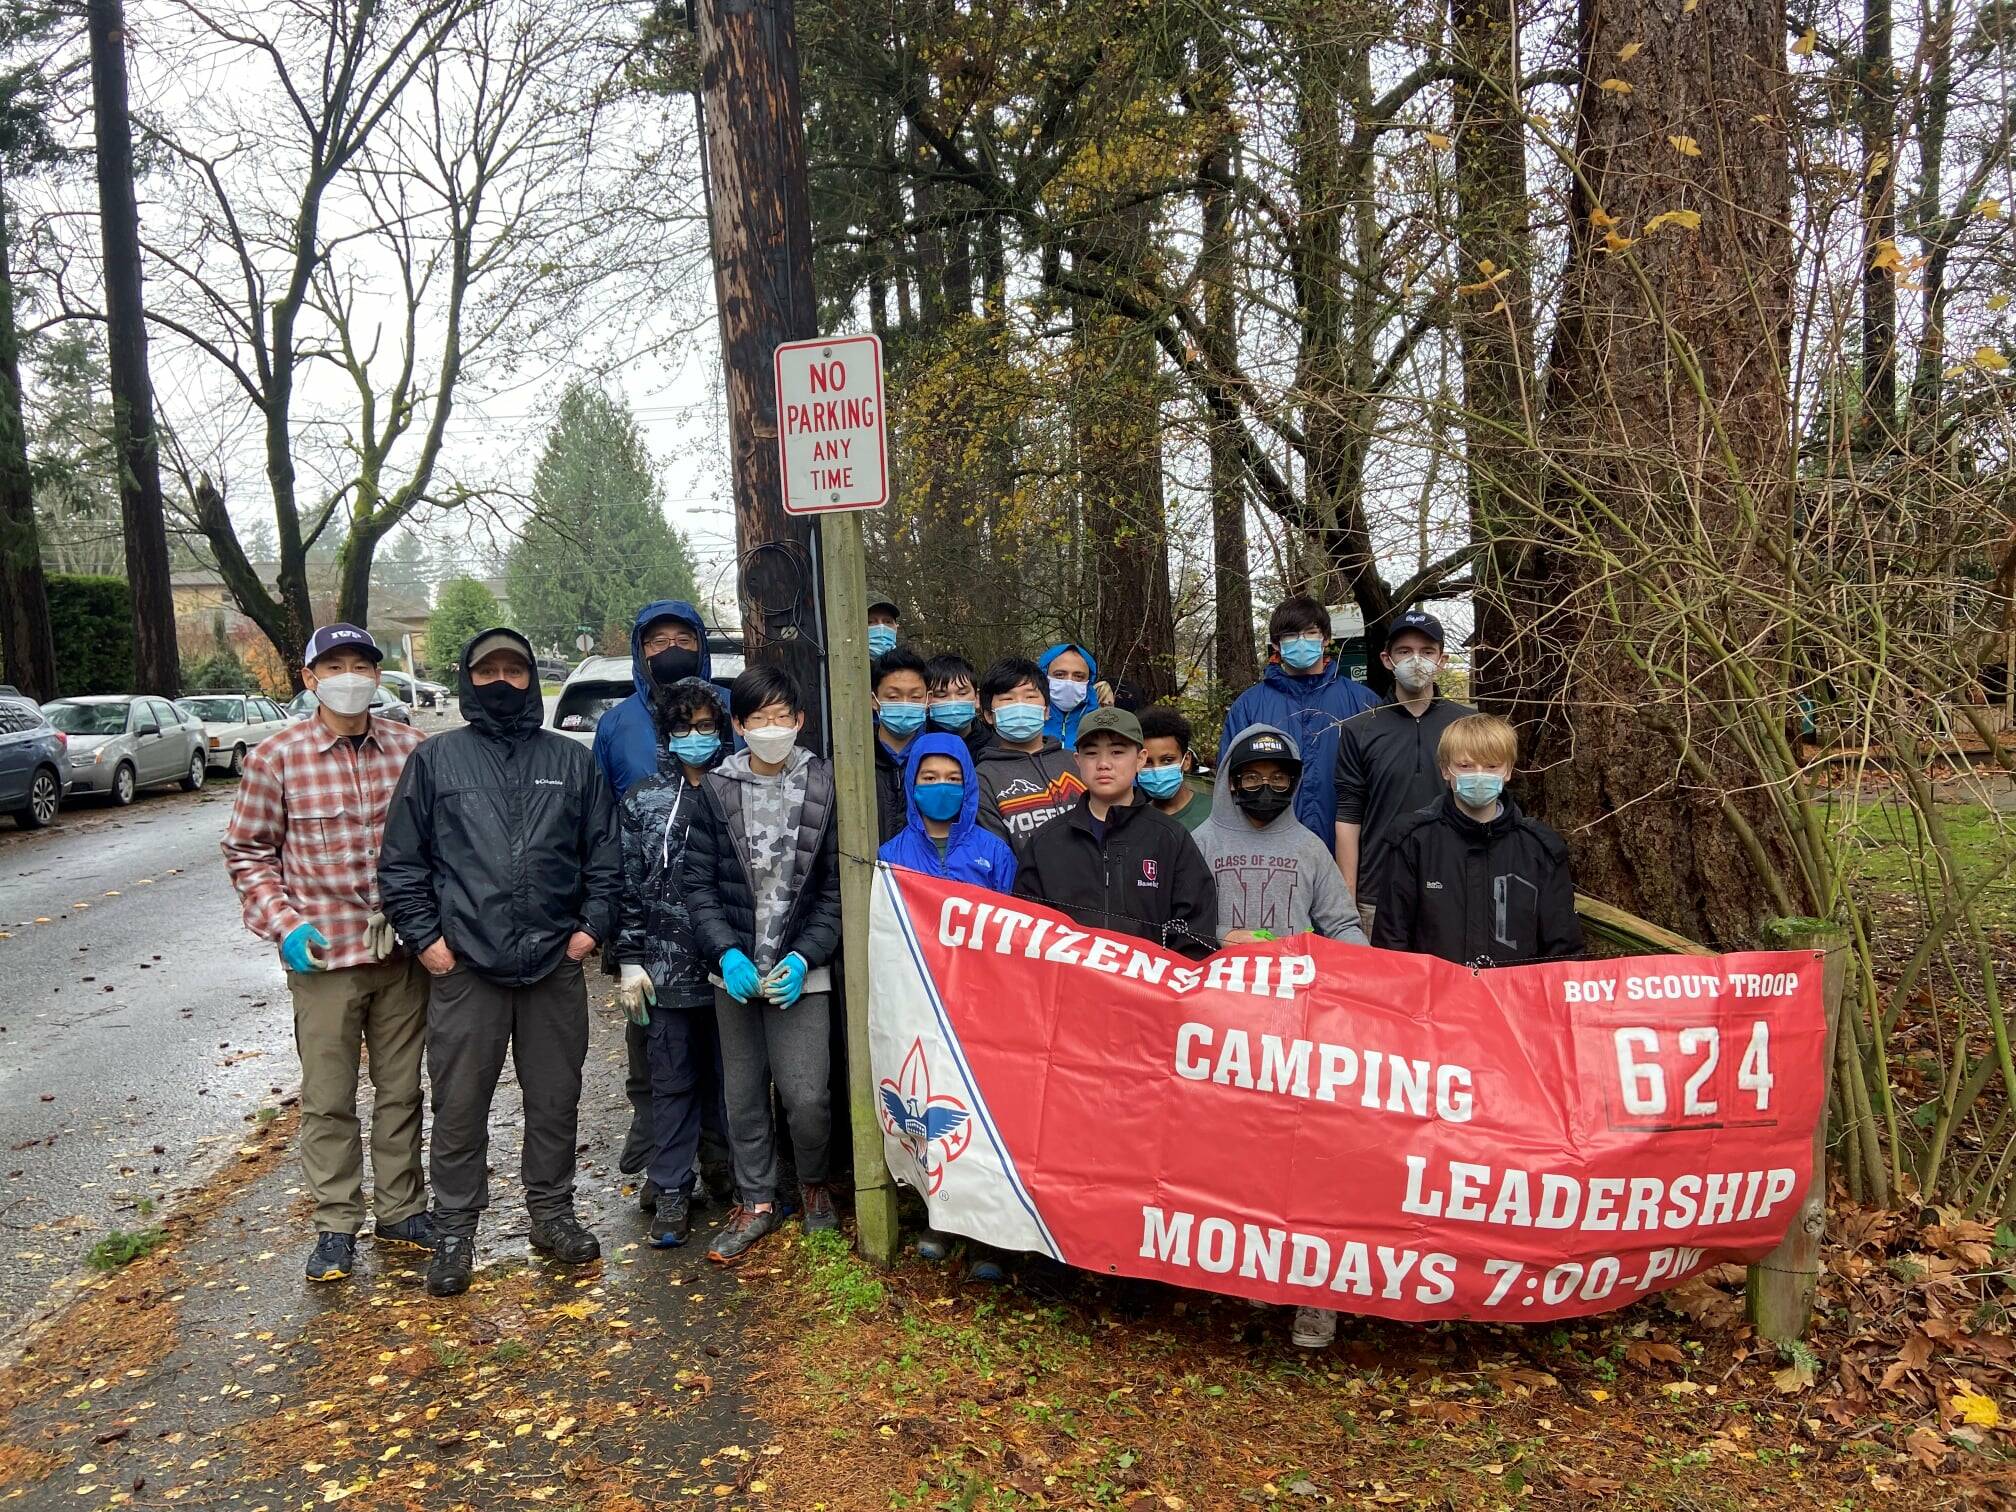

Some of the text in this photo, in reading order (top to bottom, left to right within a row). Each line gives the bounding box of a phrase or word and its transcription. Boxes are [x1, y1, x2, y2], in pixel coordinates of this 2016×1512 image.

[809, 360, 846, 394] NO
[787, 396, 874, 435] PARKING
[813, 438, 851, 462] ANY
[810, 467, 854, 491] TIME
[1147, 862, 1156, 875] H
[1215, 855, 1298, 869] CLASS OF 2027
[938, 896, 1317, 999] CITIZENSHIP
[1564, 972, 1799, 1003] BOY SCOUT TROOP
[1174, 1022, 1473, 1123] CAMPING
[1612, 1020, 1774, 1116] 624
[1401, 1155, 1796, 1231] LEADERSHIP
[1139, 1205, 1456, 1304] MONDAYS
